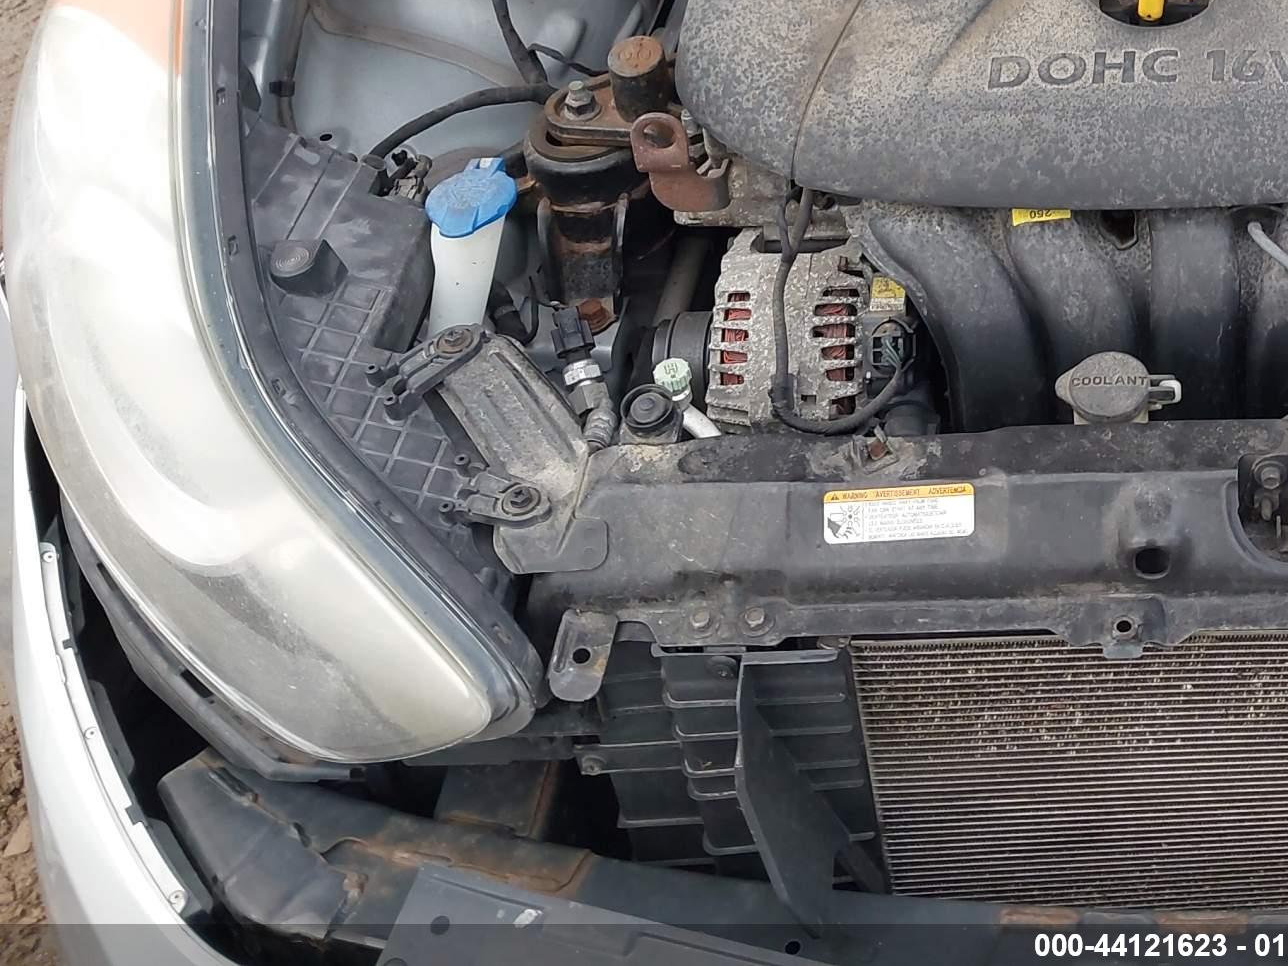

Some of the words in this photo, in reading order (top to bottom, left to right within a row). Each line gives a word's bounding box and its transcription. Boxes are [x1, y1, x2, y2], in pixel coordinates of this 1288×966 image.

[987, 49, 1179, 90] DOHC
[1071, 376, 1148, 387] COOLANT
[842, 491, 868, 499] WARNING
[875, 488, 920, 498] AVERTISSEMENT
[928, 485, 966, 495] ADVERTENCIA
